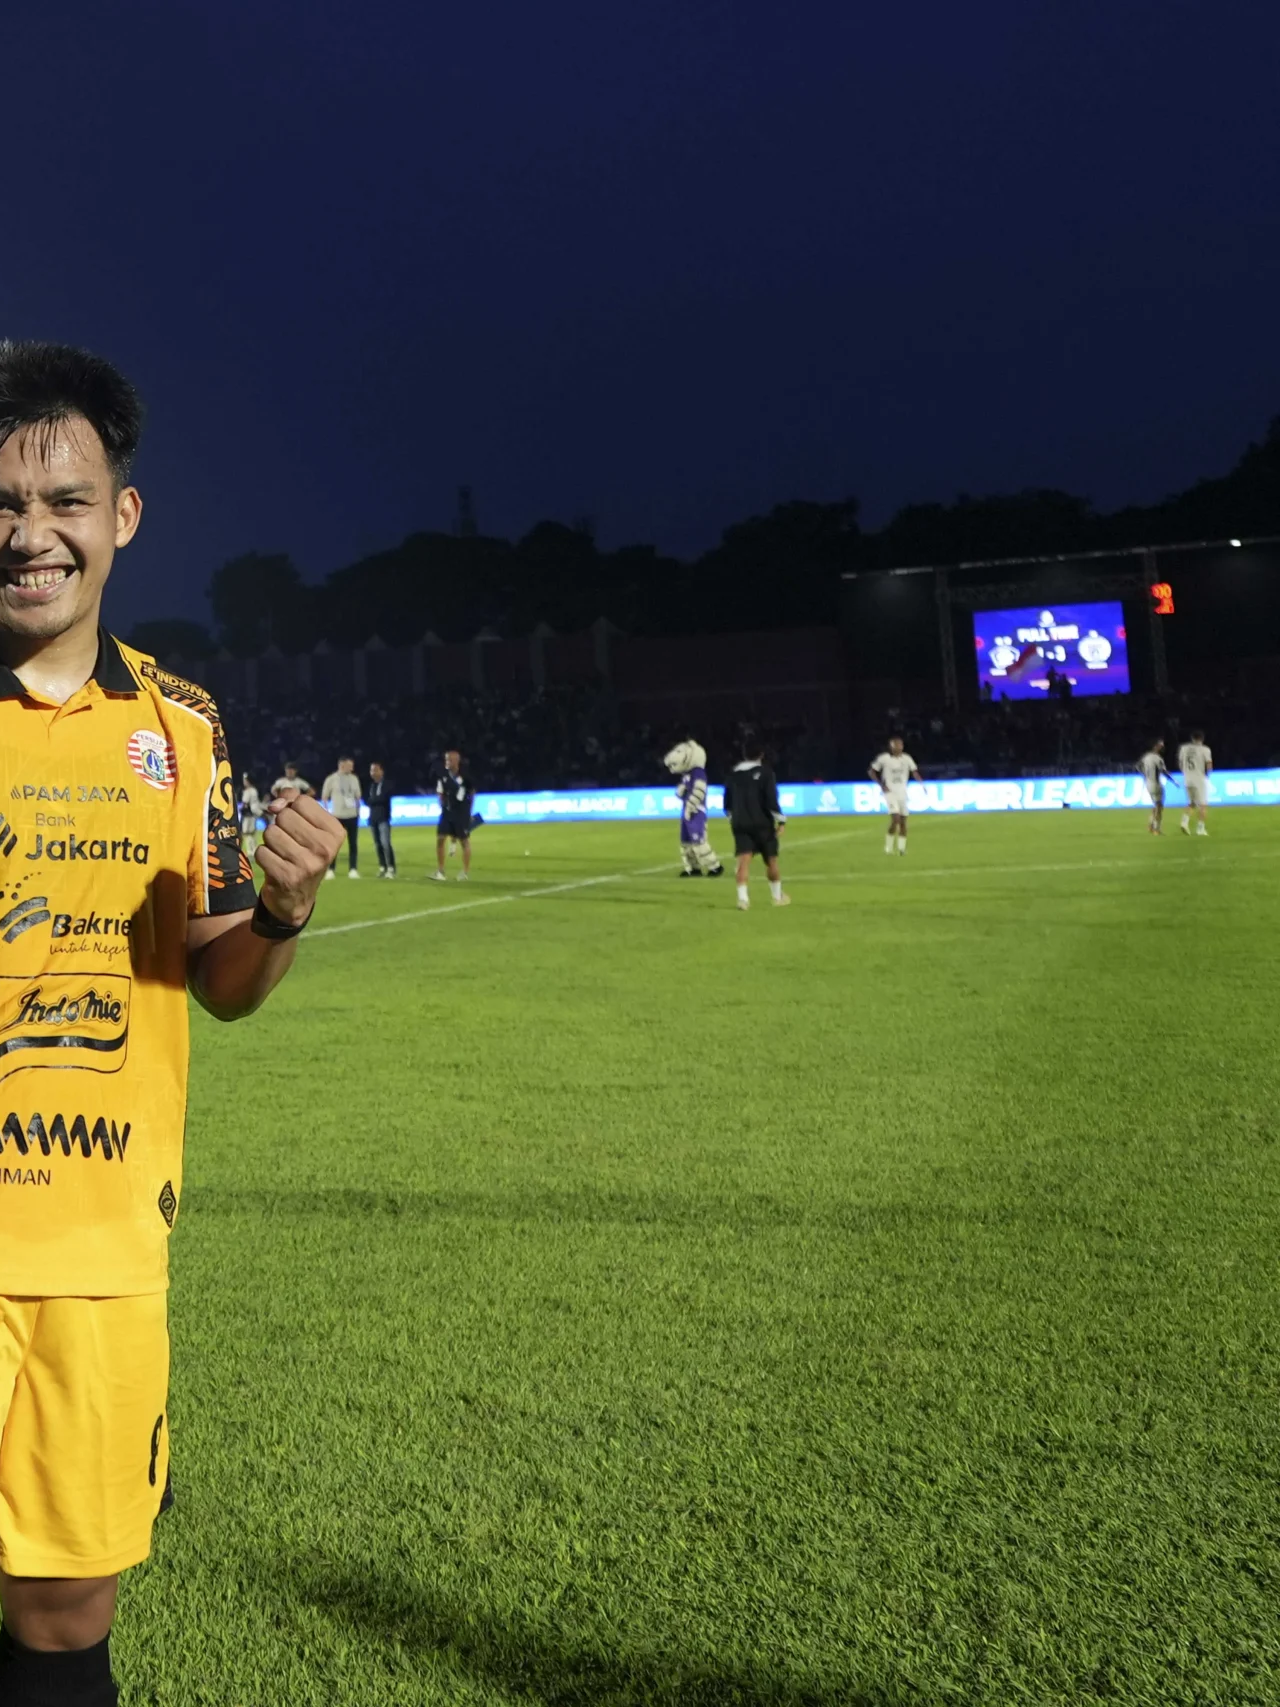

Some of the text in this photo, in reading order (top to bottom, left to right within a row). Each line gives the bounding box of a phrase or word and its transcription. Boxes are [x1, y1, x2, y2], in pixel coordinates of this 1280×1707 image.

[23, 784, 130, 803] PAM JAYA
[35, 812, 76, 827] Bank
[25, 833, 149, 865] Jakarta
[51, 911, 132, 938] Bakrie
